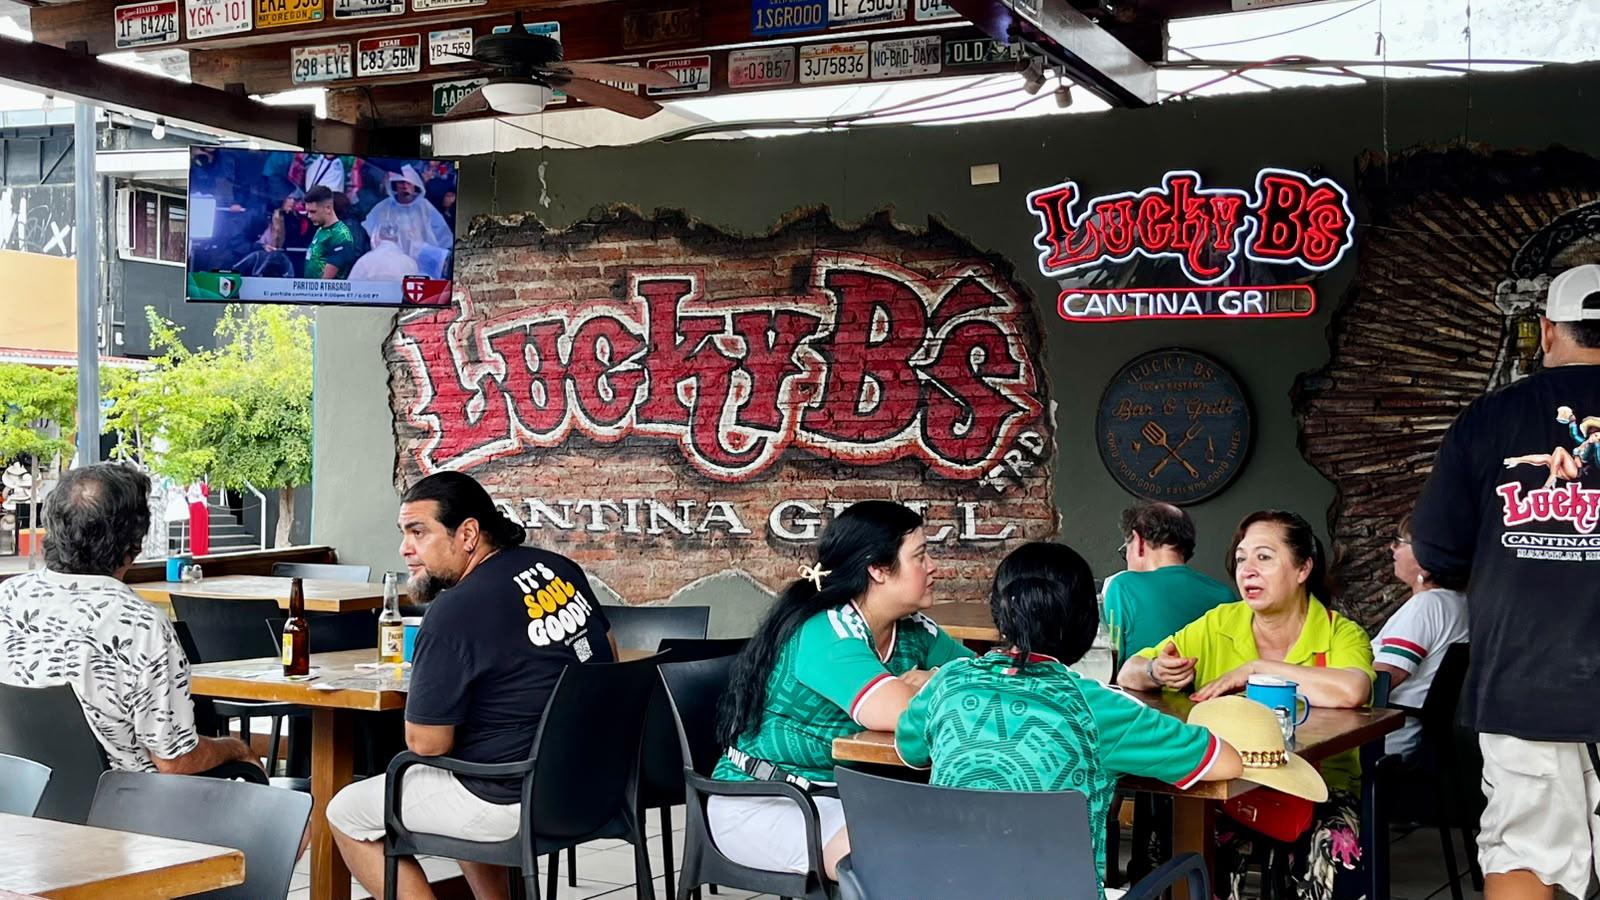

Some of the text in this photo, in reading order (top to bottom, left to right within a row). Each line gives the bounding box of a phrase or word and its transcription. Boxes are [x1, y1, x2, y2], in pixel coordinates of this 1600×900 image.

[120, 19, 132, 37] 1F
[141, 13, 174, 34] 64226
[271, 10, 307, 21] OREGON
[379, 40, 400, 48] UTAH
[954, 42, 983, 62] OLD
[361, 47, 415, 71] C83 5BN
[749, 60, 791, 80] 03857
[805, 55, 863, 76] 3J75836
[1035, 177, 1243, 276] Lucky
[293, 281, 352, 292] PARTIDO ATRASADO
[1063, 291, 1204, 316] CANTINA
[400, 275, 820, 472] Lucky
[1130, 357, 1186, 384] LUCKY
[1113, 398, 1153, 421] Bar
[1184, 397, 1234, 420] Grill
[493, 497, 752, 535] ANTINA
[513, 562, 555, 594] IT'S
[523, 576, 576, 619] SOUL
